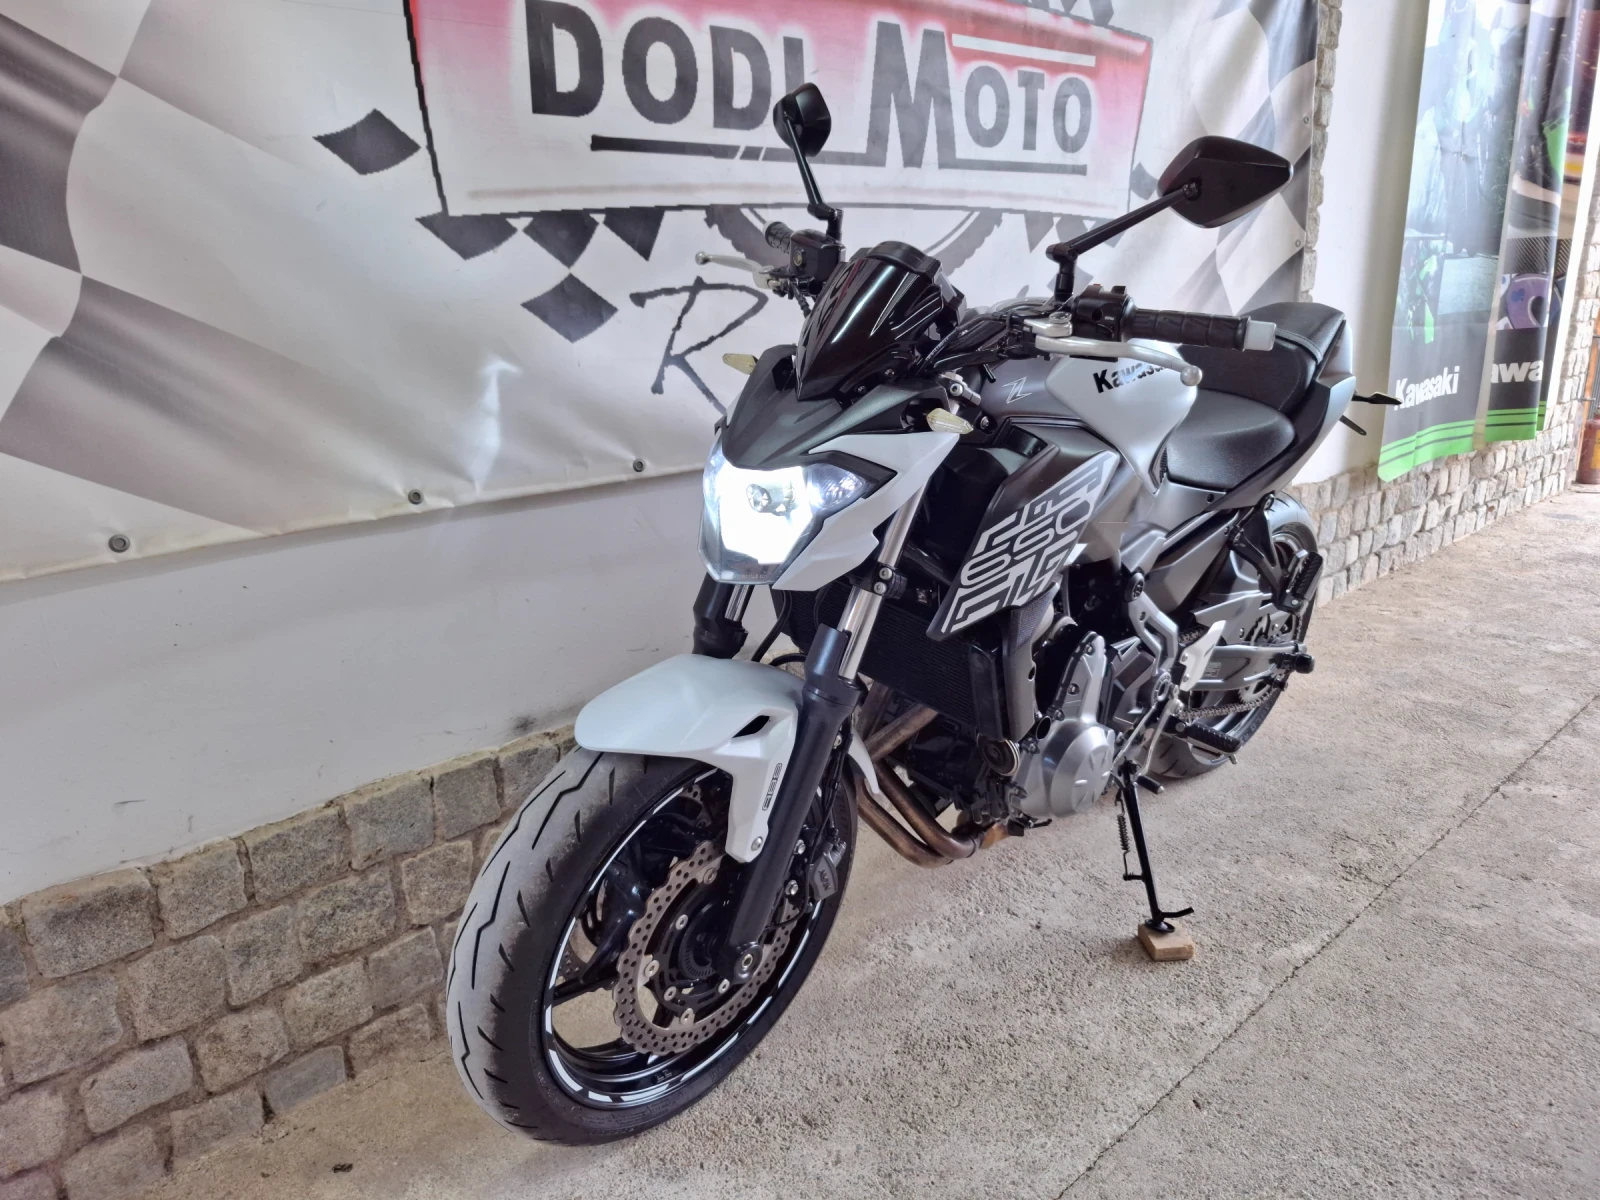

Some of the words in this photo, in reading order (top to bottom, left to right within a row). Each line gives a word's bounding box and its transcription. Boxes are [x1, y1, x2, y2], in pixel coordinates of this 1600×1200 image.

[525, 0, 805, 131] DODI
[867, 22, 1092, 168] MOTO
[1093, 361, 1164, 394] Kawas
[1394, 365, 1460, 411] Kawasaki
